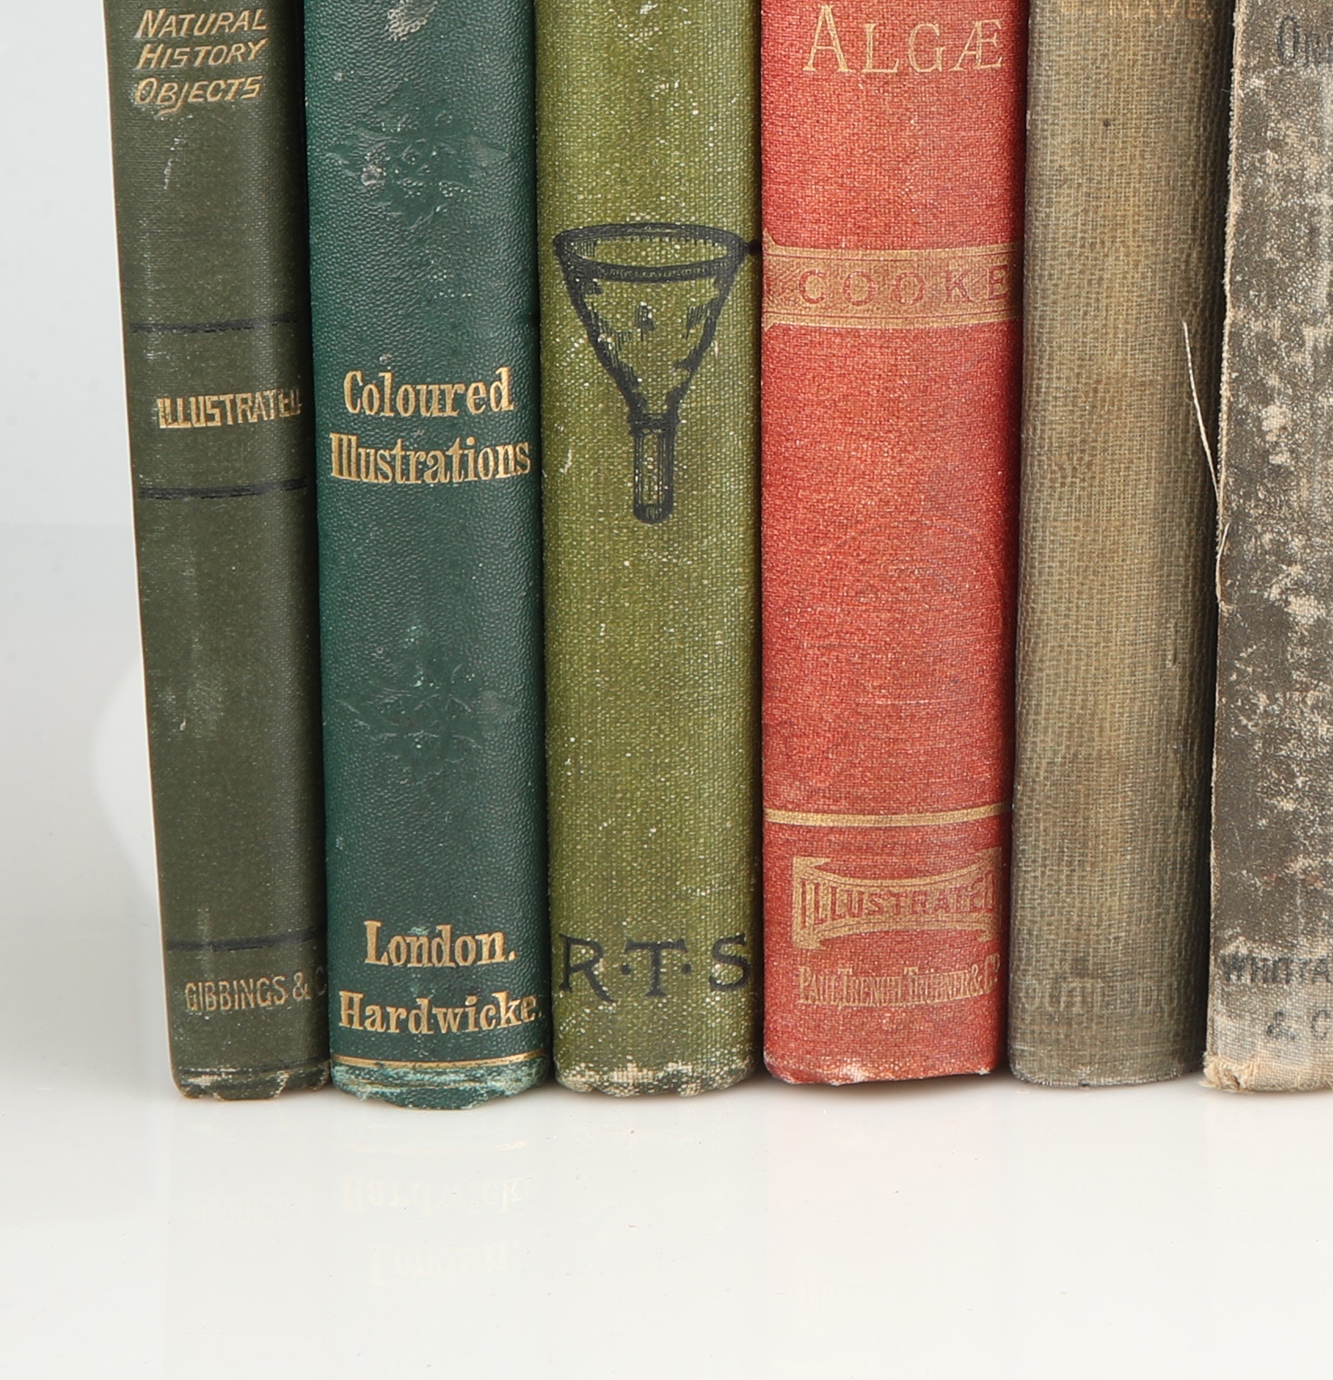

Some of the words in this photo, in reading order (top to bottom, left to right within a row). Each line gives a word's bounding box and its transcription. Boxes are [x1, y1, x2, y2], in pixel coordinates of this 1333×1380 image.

[134, 8, 268, 39] NATURAL
[135, 38, 269, 71] HISTORY
[134, 75, 263, 117] OBJECTS
[799, 265, 1010, 307] COOKE
[343, 366, 514, 417] Coloured
[329, 432, 531, 484] Illustrations
[363, 919, 517, 967] London.
[185, 975, 288, 1011] GIBBINGS
[292, 972, 312, 1001] &
